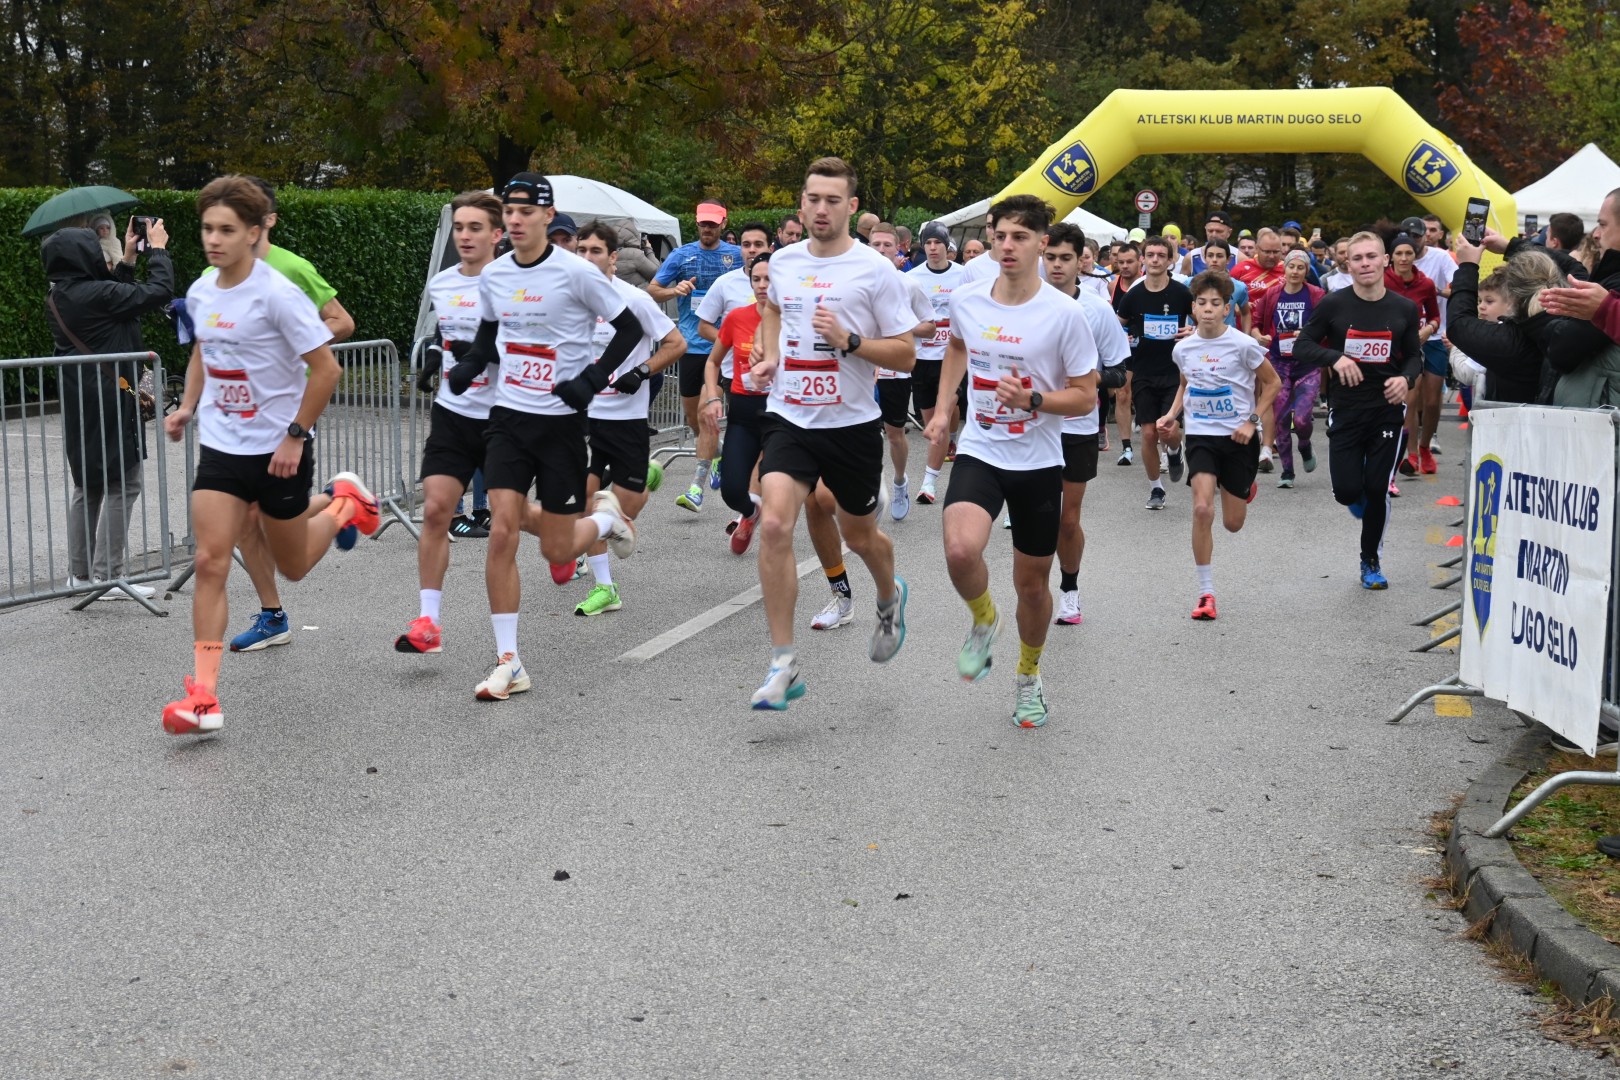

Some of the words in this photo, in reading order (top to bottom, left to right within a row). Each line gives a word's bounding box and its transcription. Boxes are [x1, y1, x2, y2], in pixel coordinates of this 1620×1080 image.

[1137, 114, 1196, 124] ATLETSKI
[1200, 114, 1233, 124] KLUB
[1236, 114, 1284, 124] MARTIN
[1288, 114, 1325, 124] DUGO
[1328, 113, 1362, 124] SELO
[1158, 324, 1176, 334] 153
[1363, 343, 1388, 356] 266
[522, 361, 552, 382] 232
[220, 384, 250, 403] 209
[802, 376, 837, 396] 263
[1207, 398, 1233, 412] 148
[1560, 482, 1600, 531] KLUB
[1517, 538, 1570, 596] MARTIN
[1548, 616, 1578, 671] SELO
